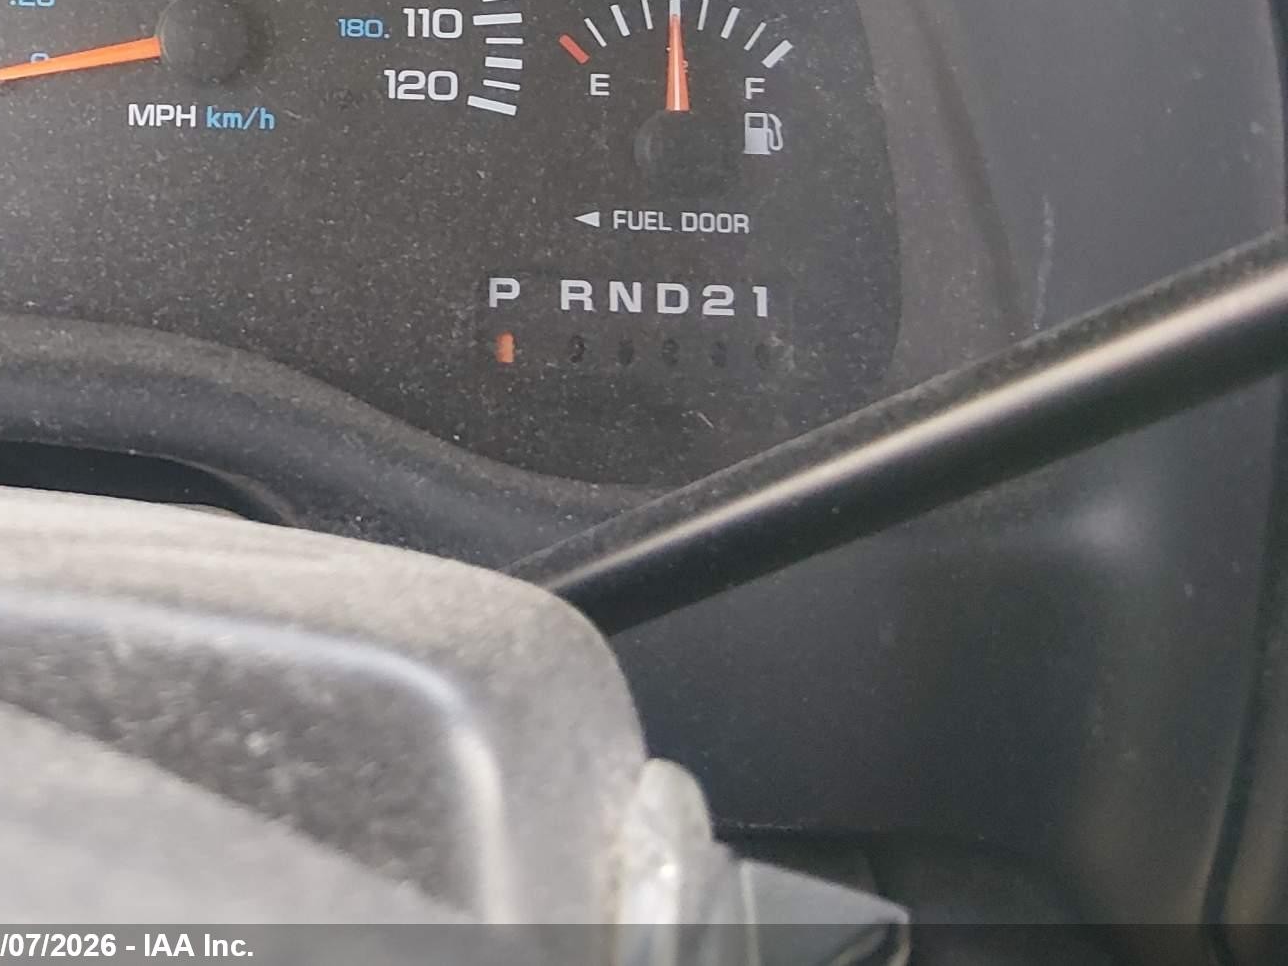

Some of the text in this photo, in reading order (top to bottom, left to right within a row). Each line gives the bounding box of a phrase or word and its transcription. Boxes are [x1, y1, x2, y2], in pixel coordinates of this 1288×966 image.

[338, 18, 383, 38] 180
[403, 7, 463, 39] 110
[383, 69, 458, 101] 120
[590, 73, 610, 96] E
[745, 77, 766, 100] F
[128, 103, 275, 130] MPH km/h
[613, 209, 750, 234] FUEL DOOR
[489, 277, 521, 308] P
[560, 279, 594, 311] R
[609, 281, 642, 313] N
[656, 282, 689, 315] D
[702, 284, 735, 316] 2
